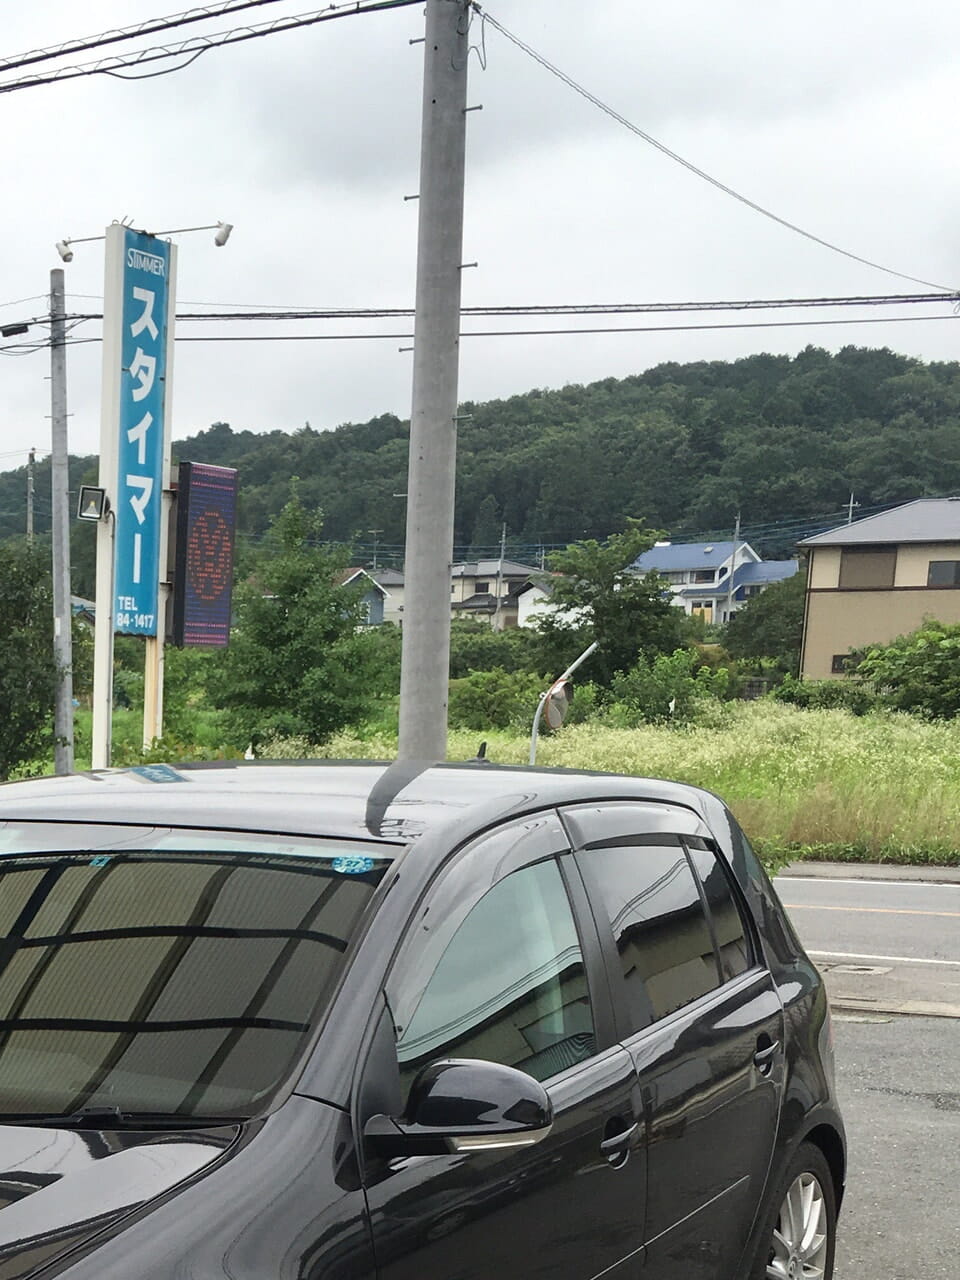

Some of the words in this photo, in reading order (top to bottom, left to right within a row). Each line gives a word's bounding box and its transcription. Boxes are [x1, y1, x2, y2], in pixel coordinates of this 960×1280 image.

[126, 286, 159, 584] スタイマー
[118, 596, 138, 611] TEL
